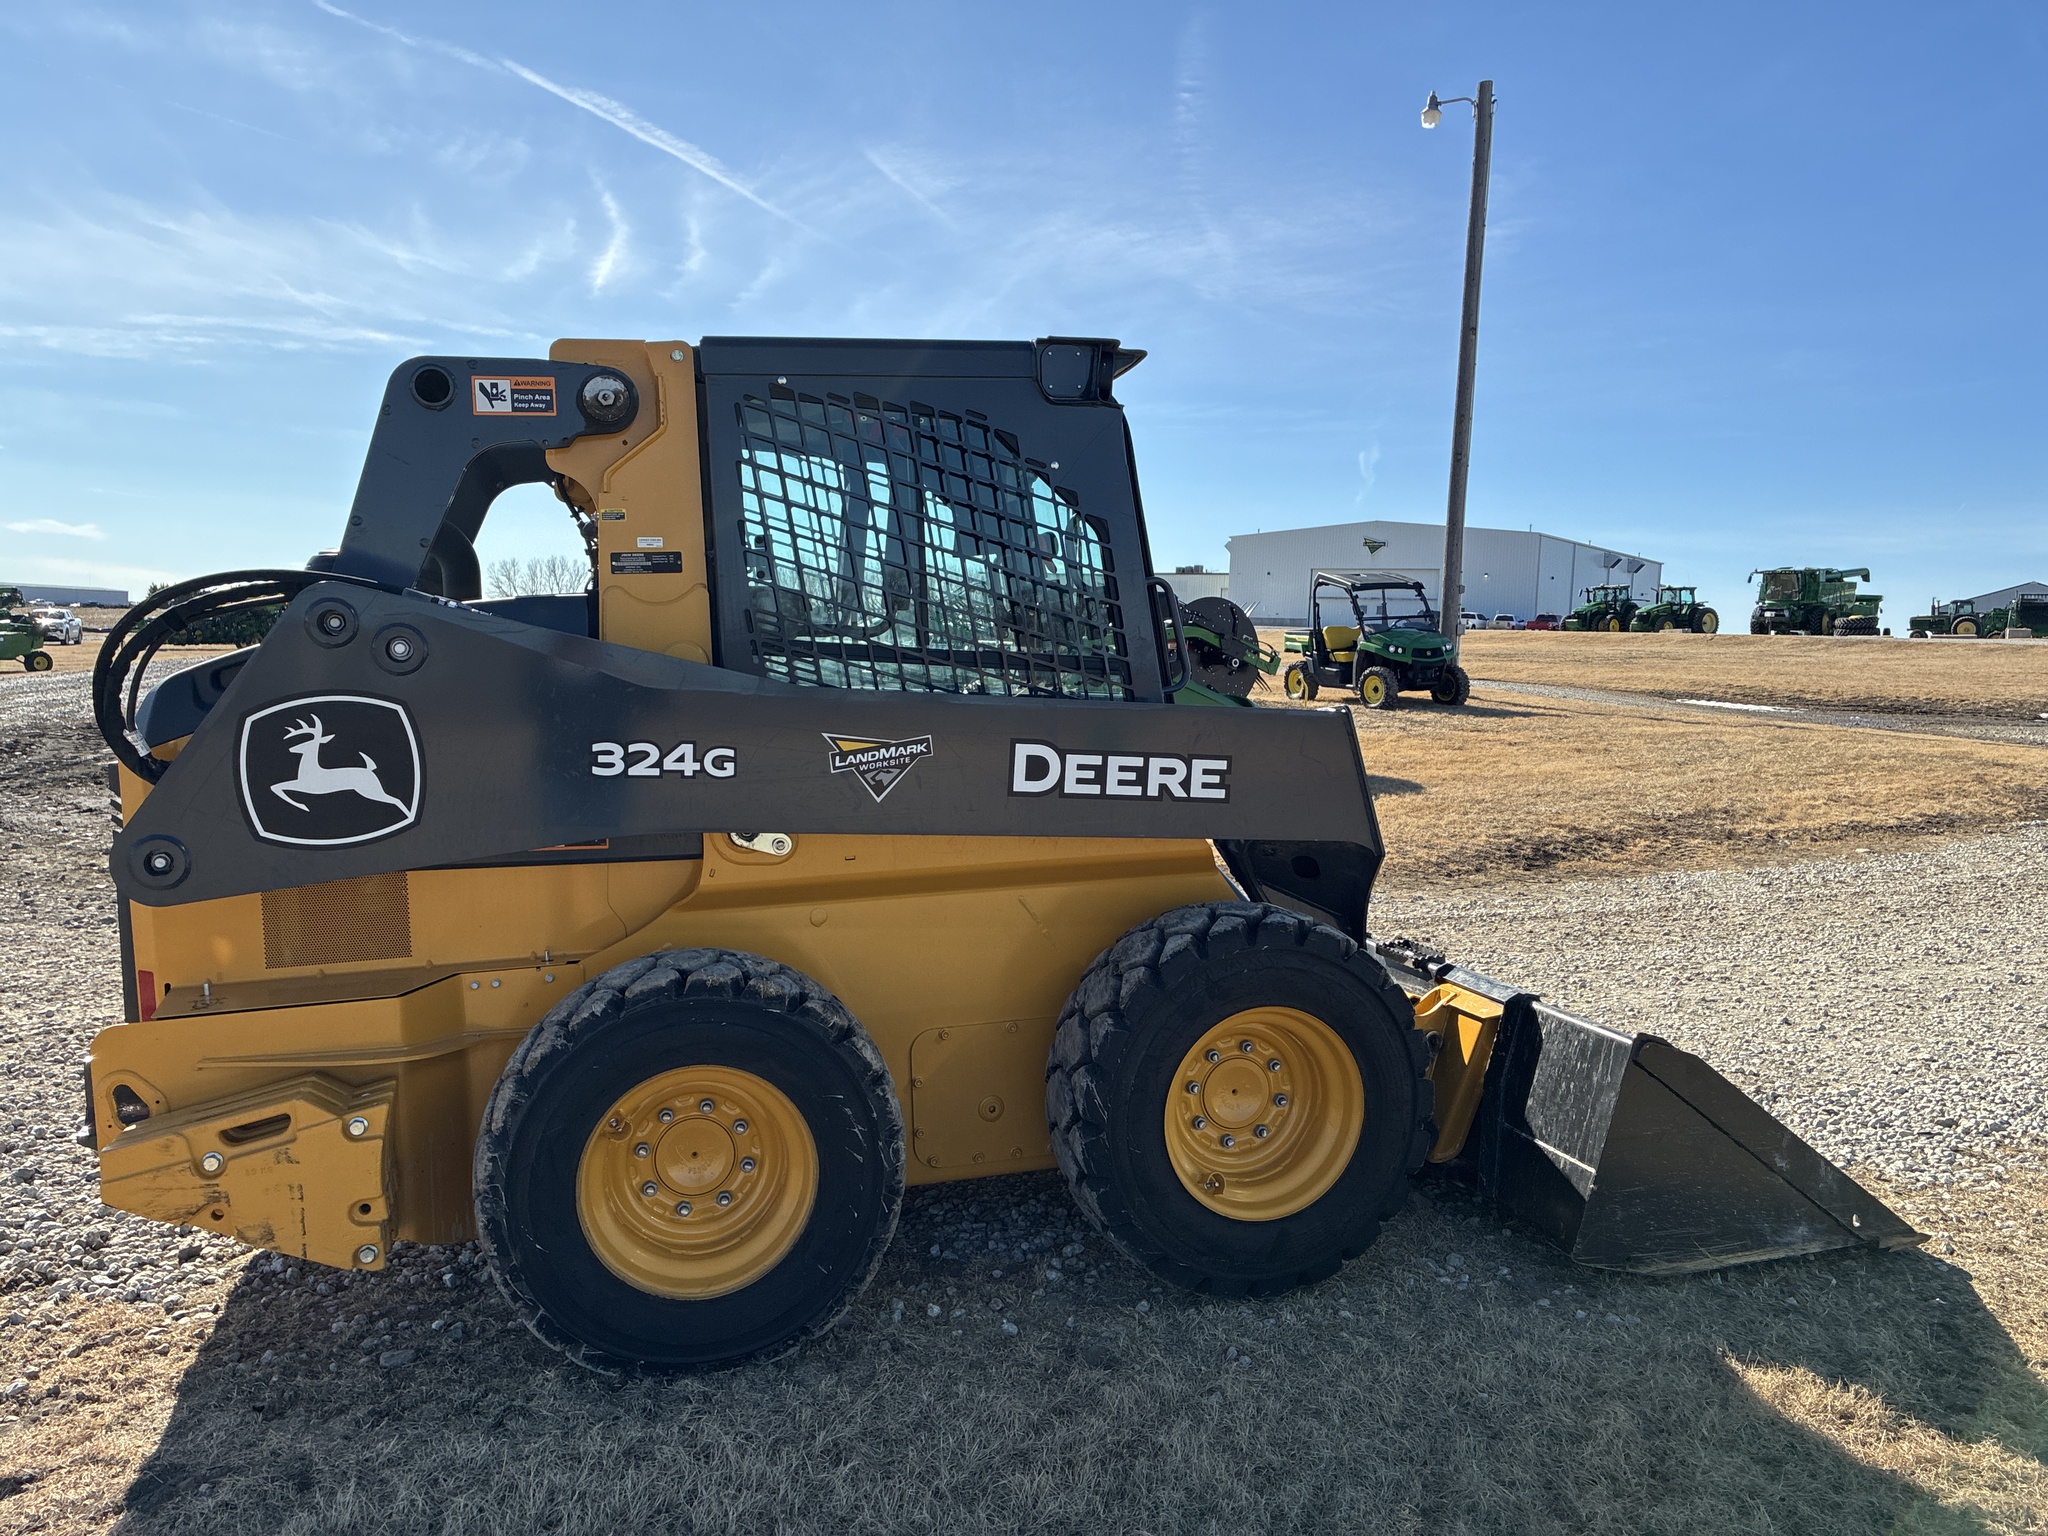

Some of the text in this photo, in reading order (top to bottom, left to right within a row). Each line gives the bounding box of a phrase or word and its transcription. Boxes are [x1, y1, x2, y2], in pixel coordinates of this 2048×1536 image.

[591, 742, 735, 778] 324G
[835, 742, 929, 767] LANDMARK
[859, 756, 911, 771] WORKSITE
[1012, 743, 1228, 799] DEERE
